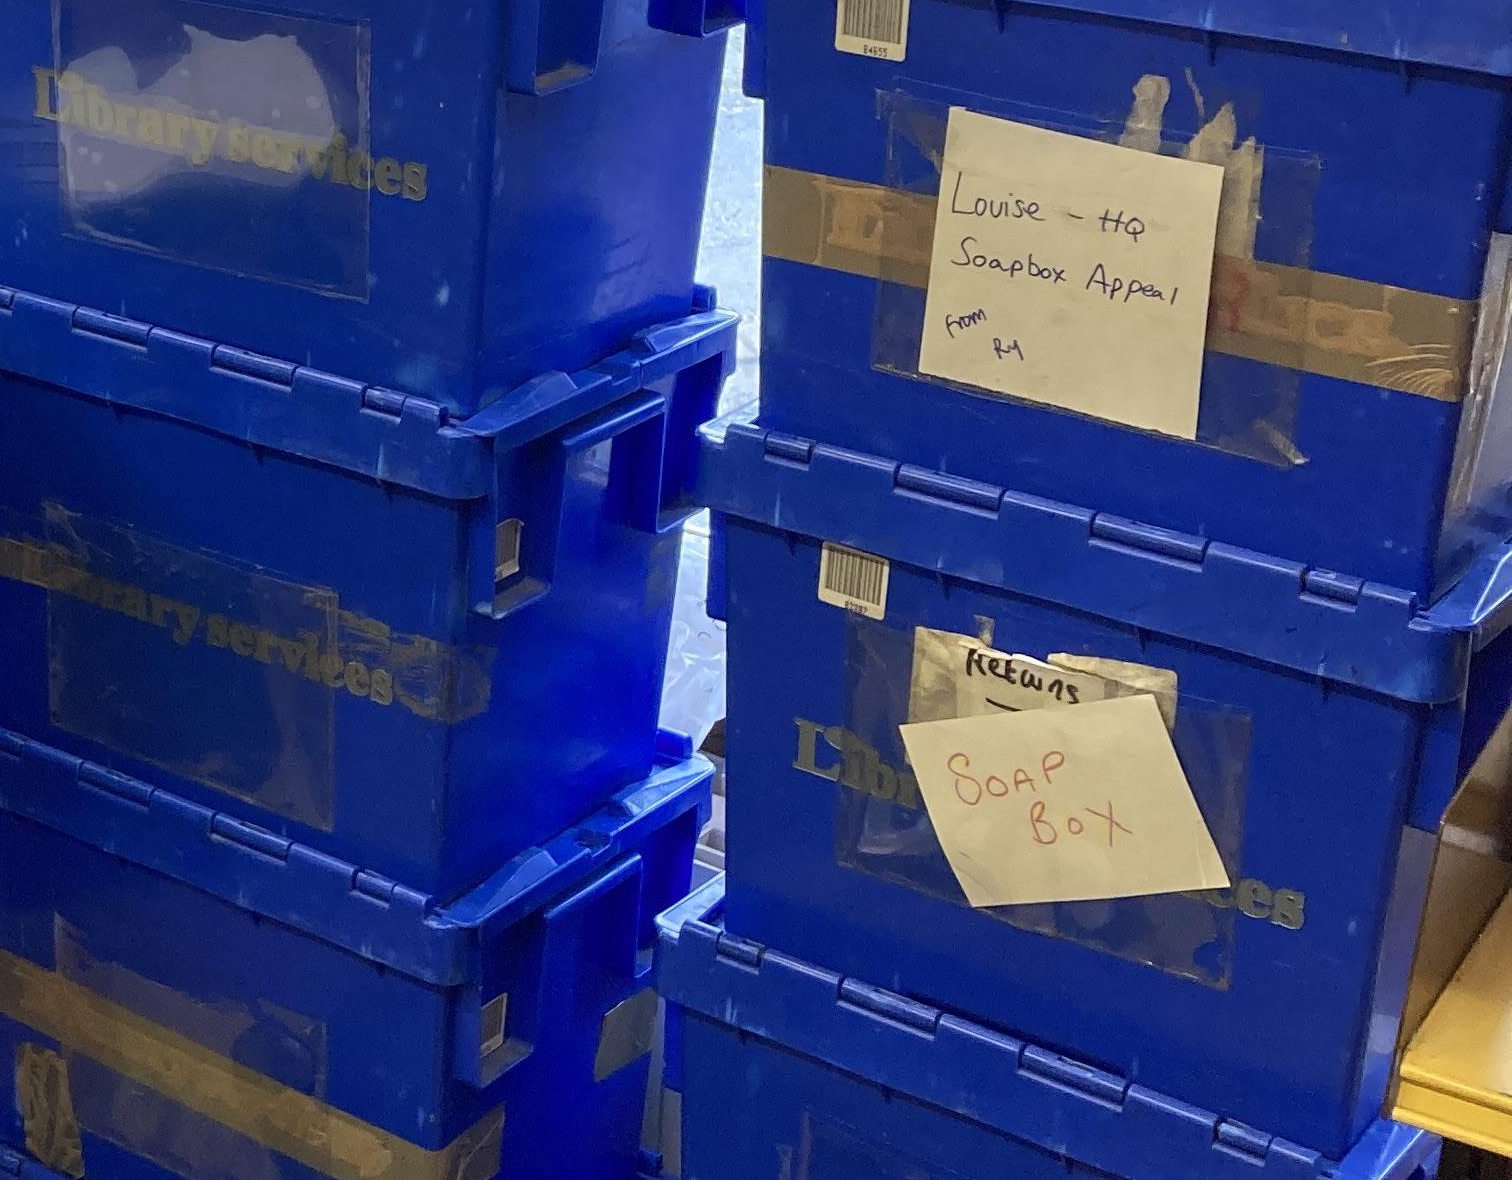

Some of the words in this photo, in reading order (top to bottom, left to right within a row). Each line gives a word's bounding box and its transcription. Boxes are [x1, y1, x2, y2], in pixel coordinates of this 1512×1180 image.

[32, 65, 219, 166] Library
[226, 122, 428, 202] services
[951, 171, 1047, 222] Louise
[1098, 208, 1146, 243] HQ
[951, 236, 1068, 284] Soapbox
[1085, 263, 1179, 306] Appeal
[792, 716, 920, 810] Libr
[947, 751, 1065, 806] SOAP
